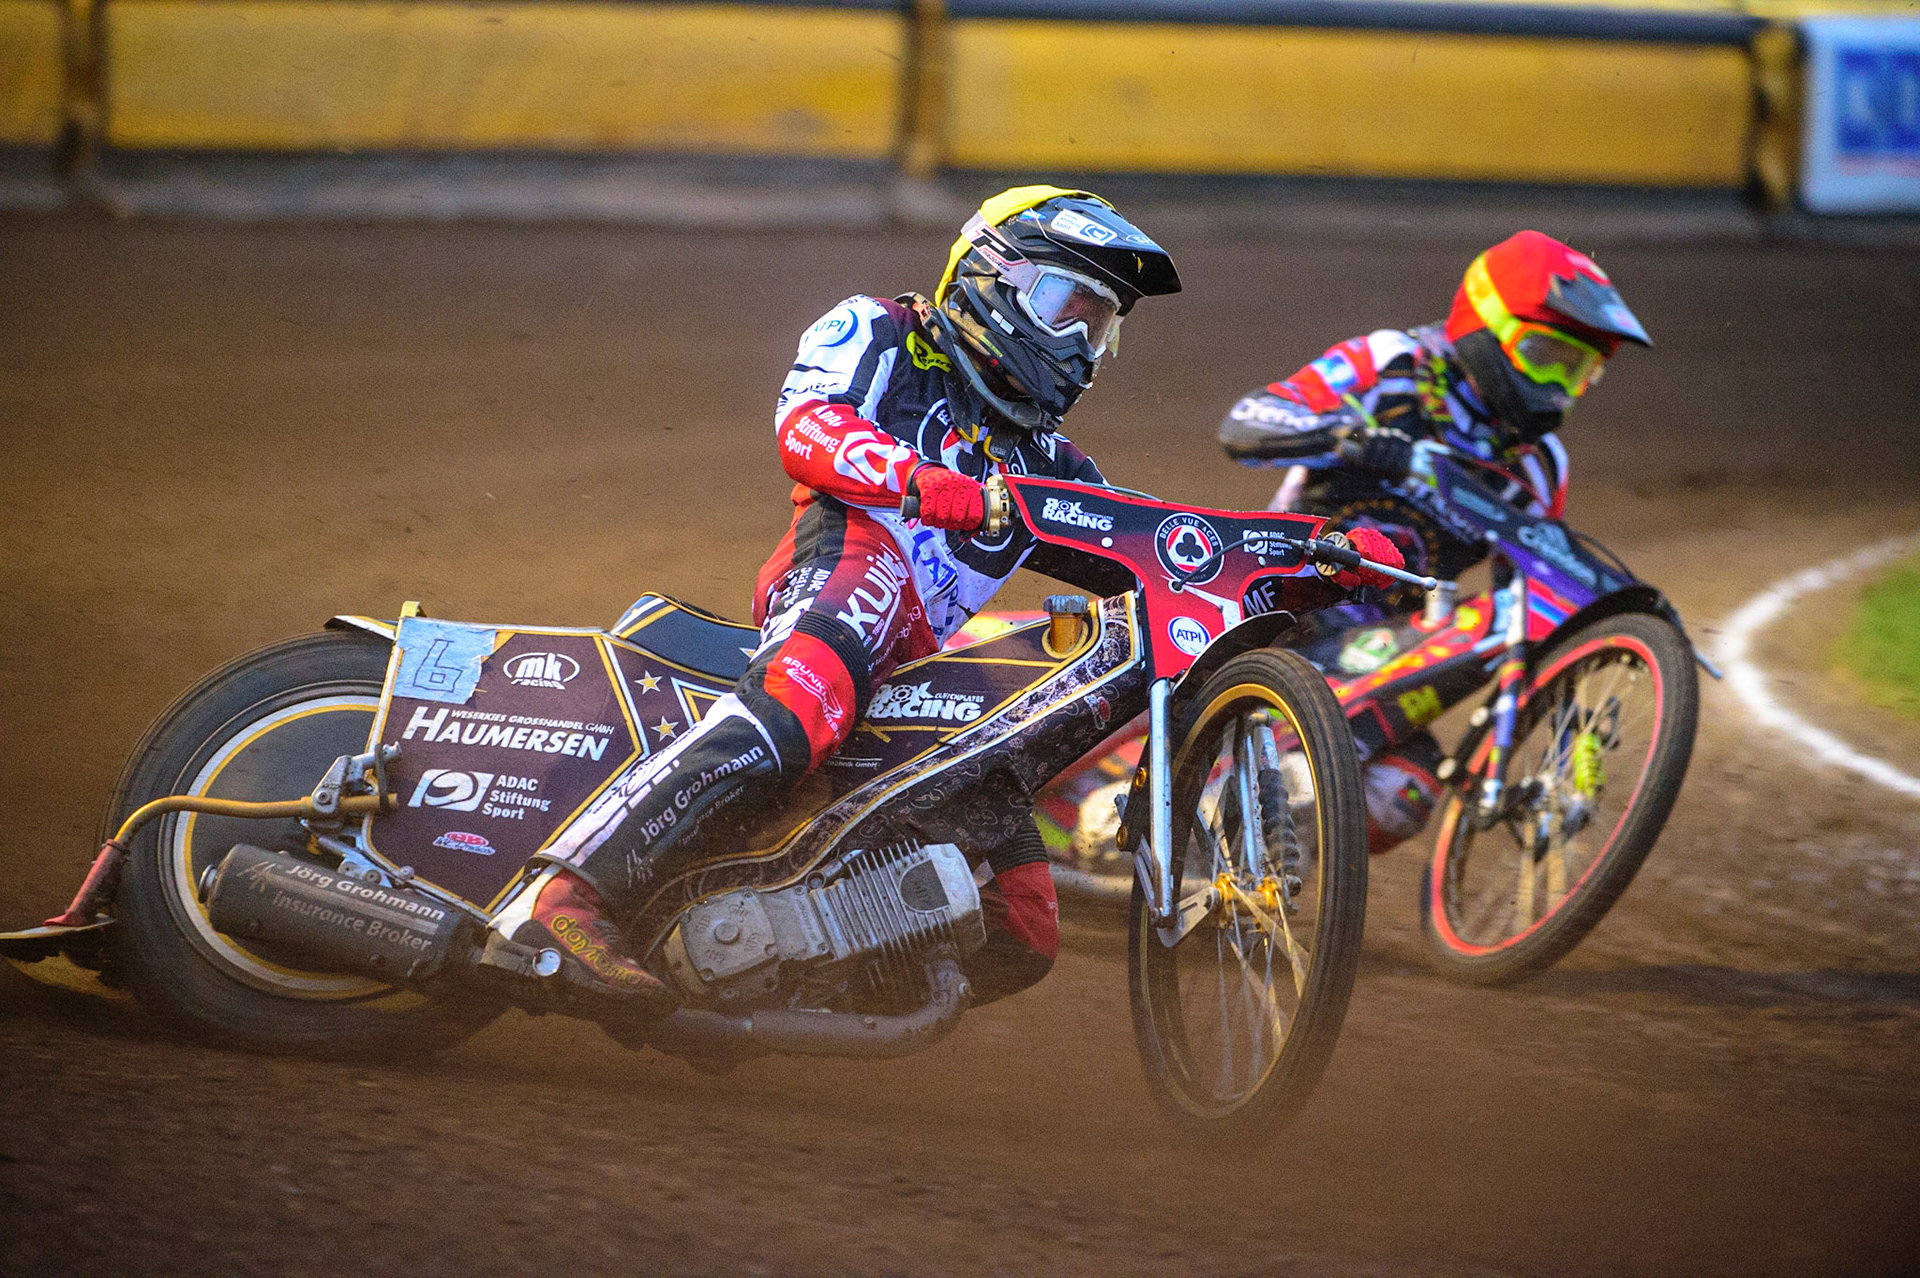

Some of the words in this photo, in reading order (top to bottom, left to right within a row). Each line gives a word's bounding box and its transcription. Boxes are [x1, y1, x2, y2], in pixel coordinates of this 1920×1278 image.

[784, 429, 813, 460] Sport
[794, 415, 841, 454] Stiftung
[1041, 505, 1113, 532] RACING
[1159, 518, 1180, 540] BELLE
[1181, 516, 1200, 528] VUE
[1201, 525, 1219, 547] ACES
[1268, 547, 1285, 557] Sport
[806, 567, 832, 592] ADAC
[1176, 628, 1202, 643] ATPI
[412, 638, 464, 694] 6
[514, 652, 562, 682] mk
[510, 678, 566, 690] racing
[450, 709, 508, 723] WESERKIES
[508, 714, 584, 730] GROSSHANDEL
[864, 699, 982, 722] RACING
[402, 706, 610, 762] HAUMERSEN
[496, 774, 539, 792] ADAC
[640, 806, 677, 846] Jörg
[674, 745, 765, 810] Grohmann
[482, 802, 525, 820] Sport
[489, 790, 552, 812] Stiftung
[285, 864, 335, 889] Jörg
[335, 879, 446, 921] Grohmann
[366, 919, 433, 952] Broker
